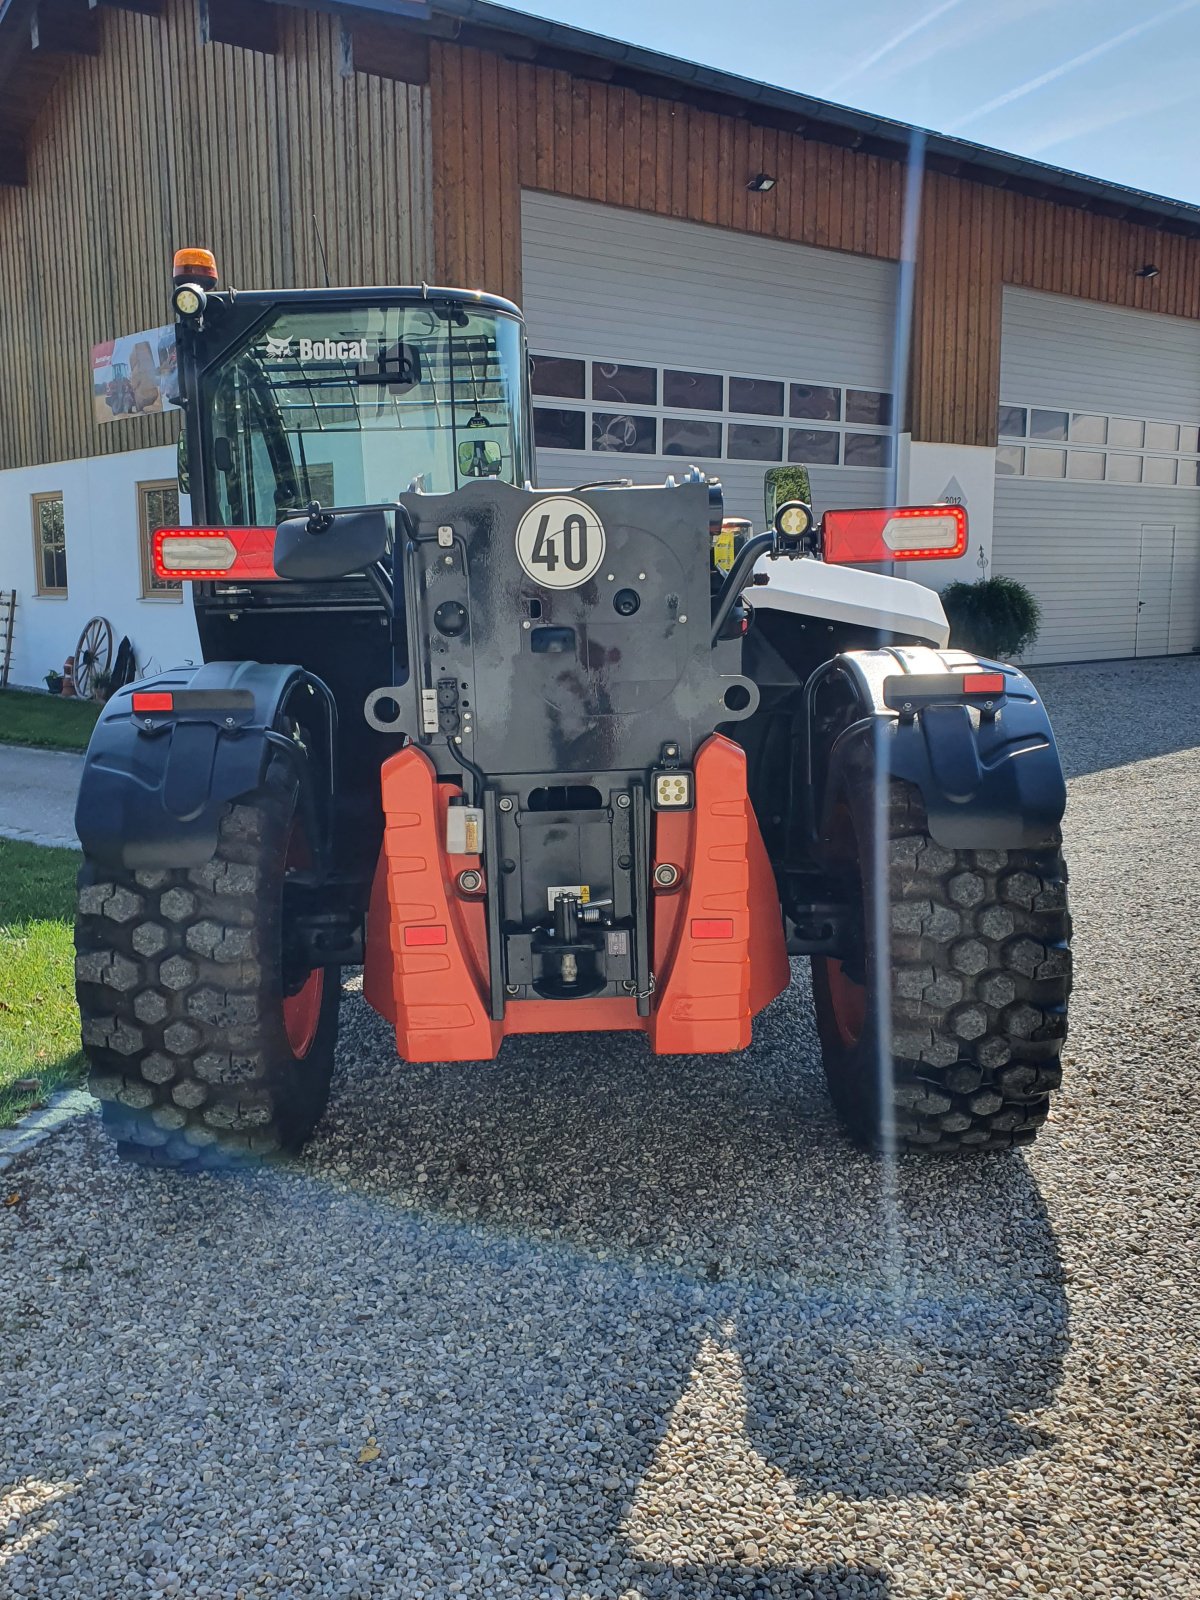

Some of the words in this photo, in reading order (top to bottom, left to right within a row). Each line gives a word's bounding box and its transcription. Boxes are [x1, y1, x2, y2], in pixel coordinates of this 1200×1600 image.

[299, 338, 368, 360] Bobcat
[945, 496, 961, 504] 2012
[532, 513, 588, 571] 40
